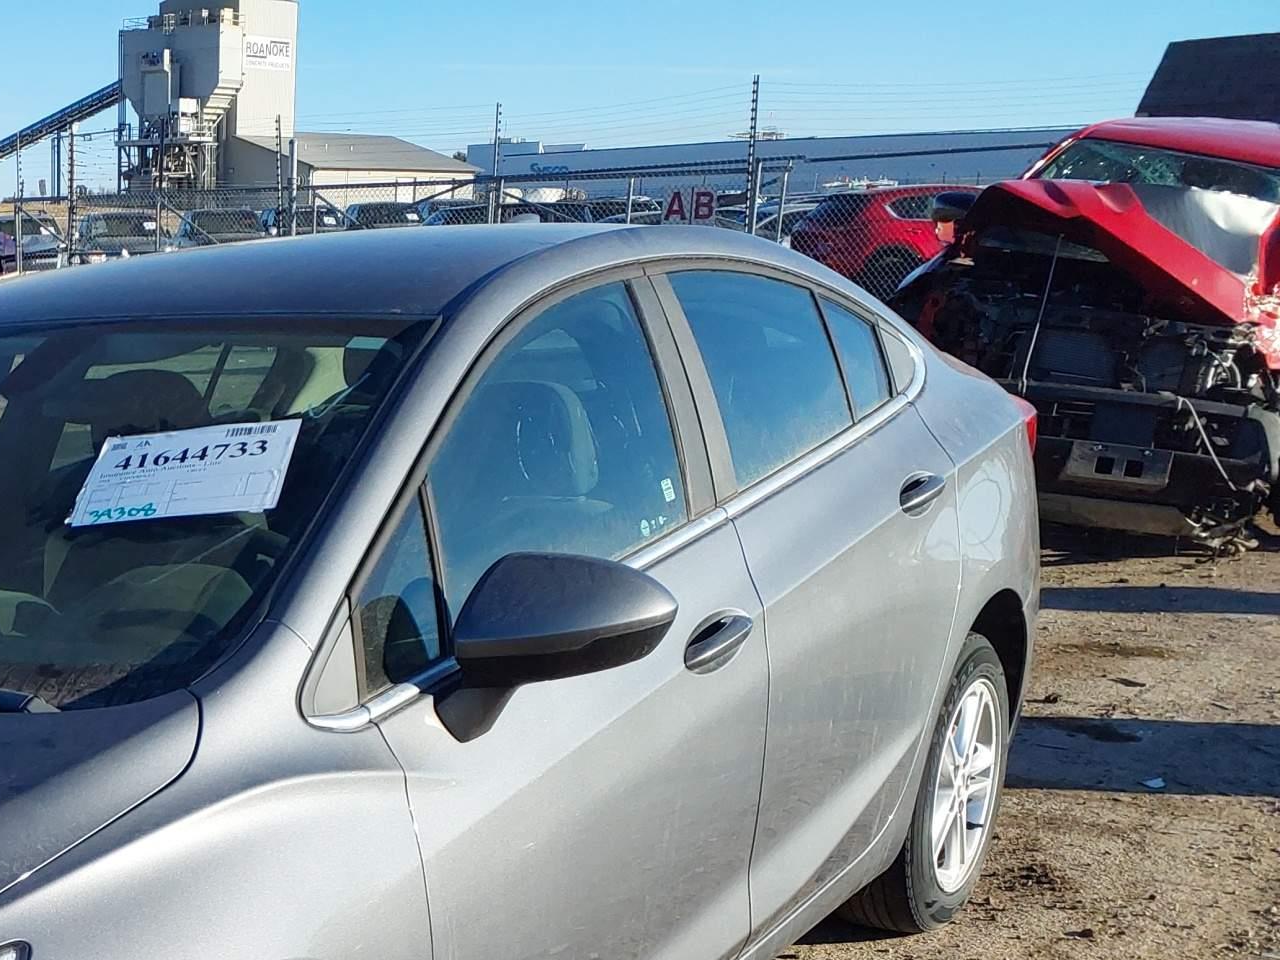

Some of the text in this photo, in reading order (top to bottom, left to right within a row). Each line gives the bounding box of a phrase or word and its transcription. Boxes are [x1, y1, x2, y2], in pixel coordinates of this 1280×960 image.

[246, 41, 290, 57] ROANOKE
[663, 191, 714, 220] A B
[114, 439, 269, 470] 41644733
